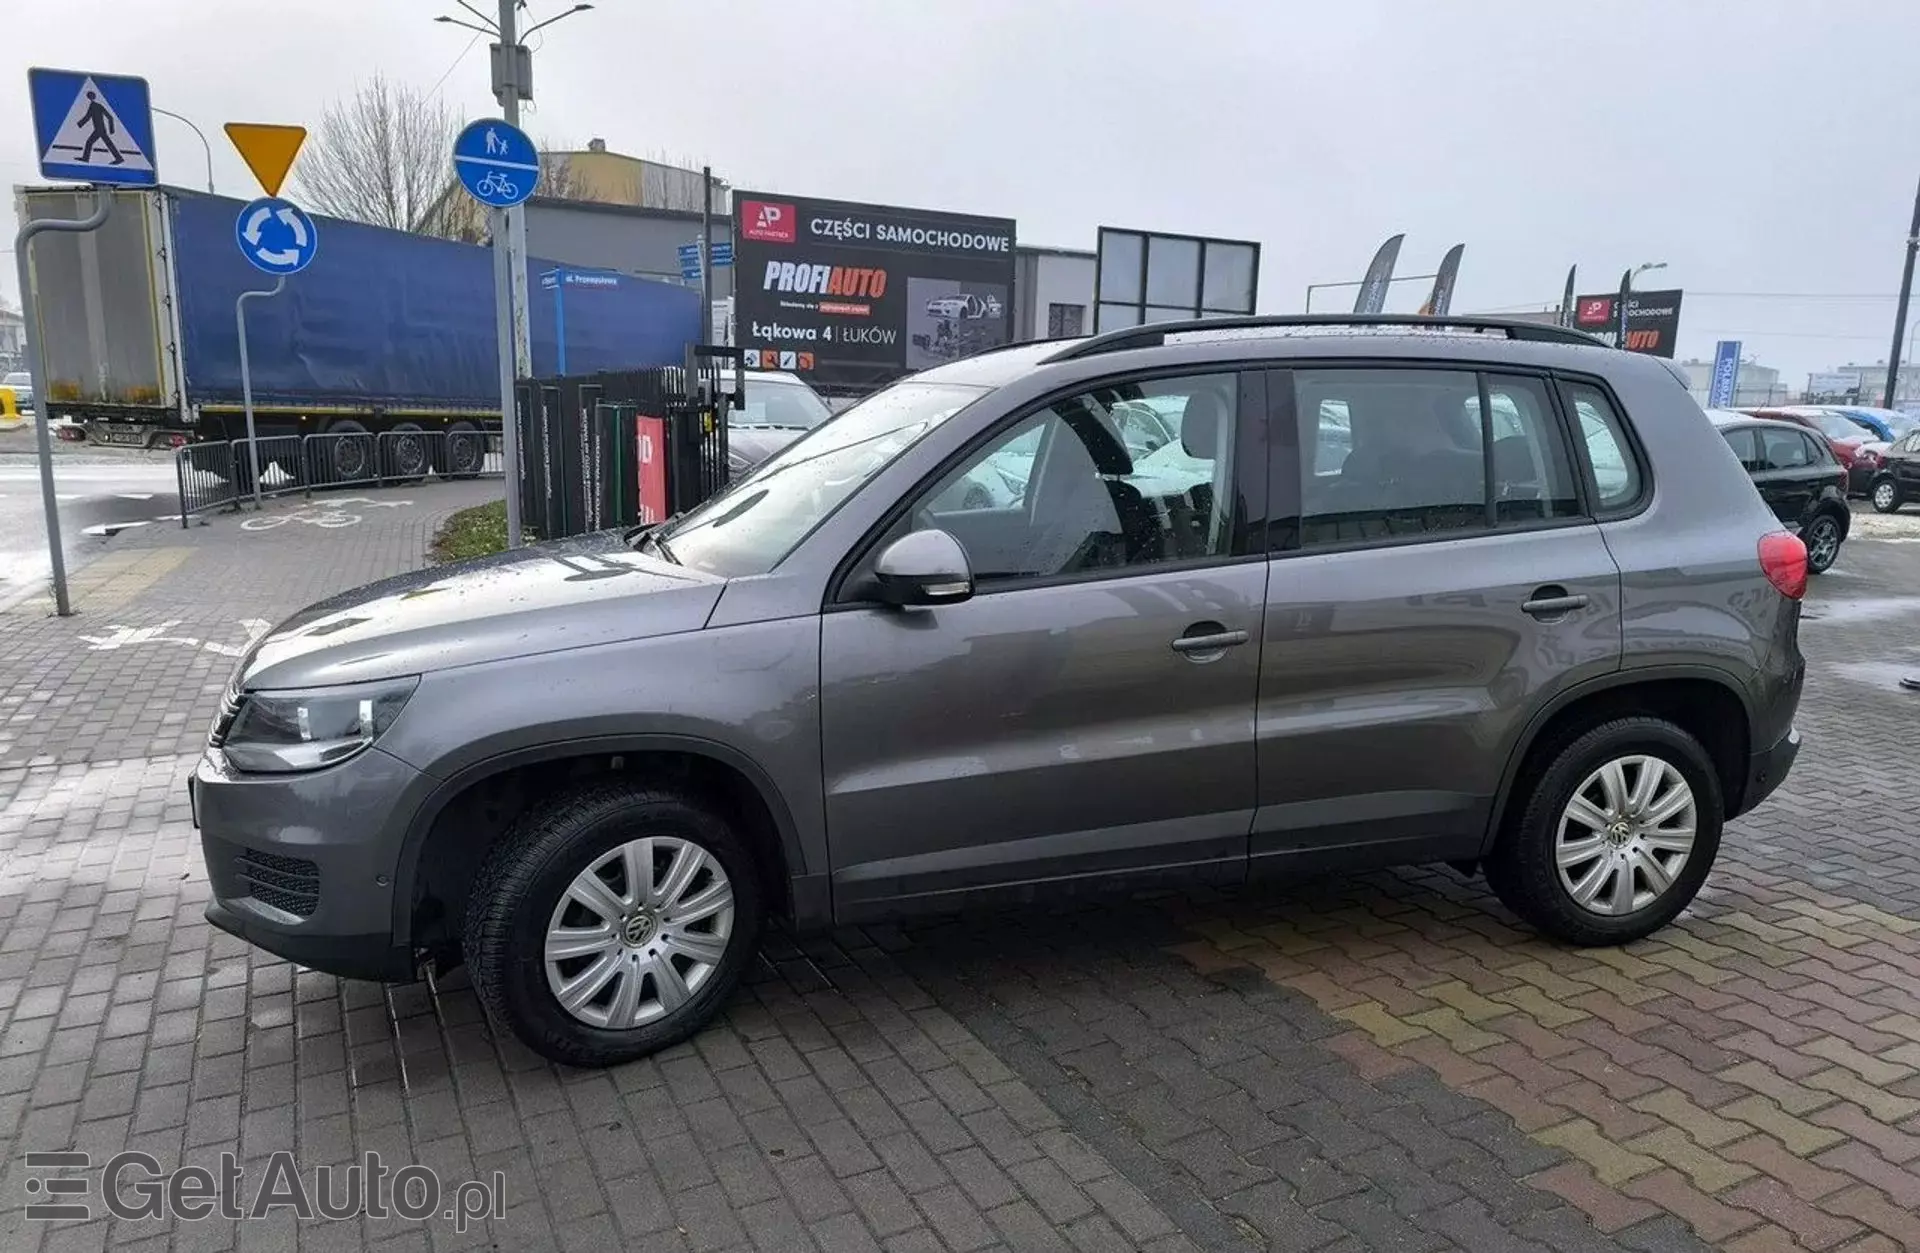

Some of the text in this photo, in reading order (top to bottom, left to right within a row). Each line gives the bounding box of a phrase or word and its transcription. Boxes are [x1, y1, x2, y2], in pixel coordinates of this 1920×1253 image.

[810, 217, 1009, 252] CZĘŚCI SAMOCHODOWE
[763, 260, 887, 298] PROFIAUTO
[751, 320, 897, 345] Łąkowa 4 ŁUKÓW
